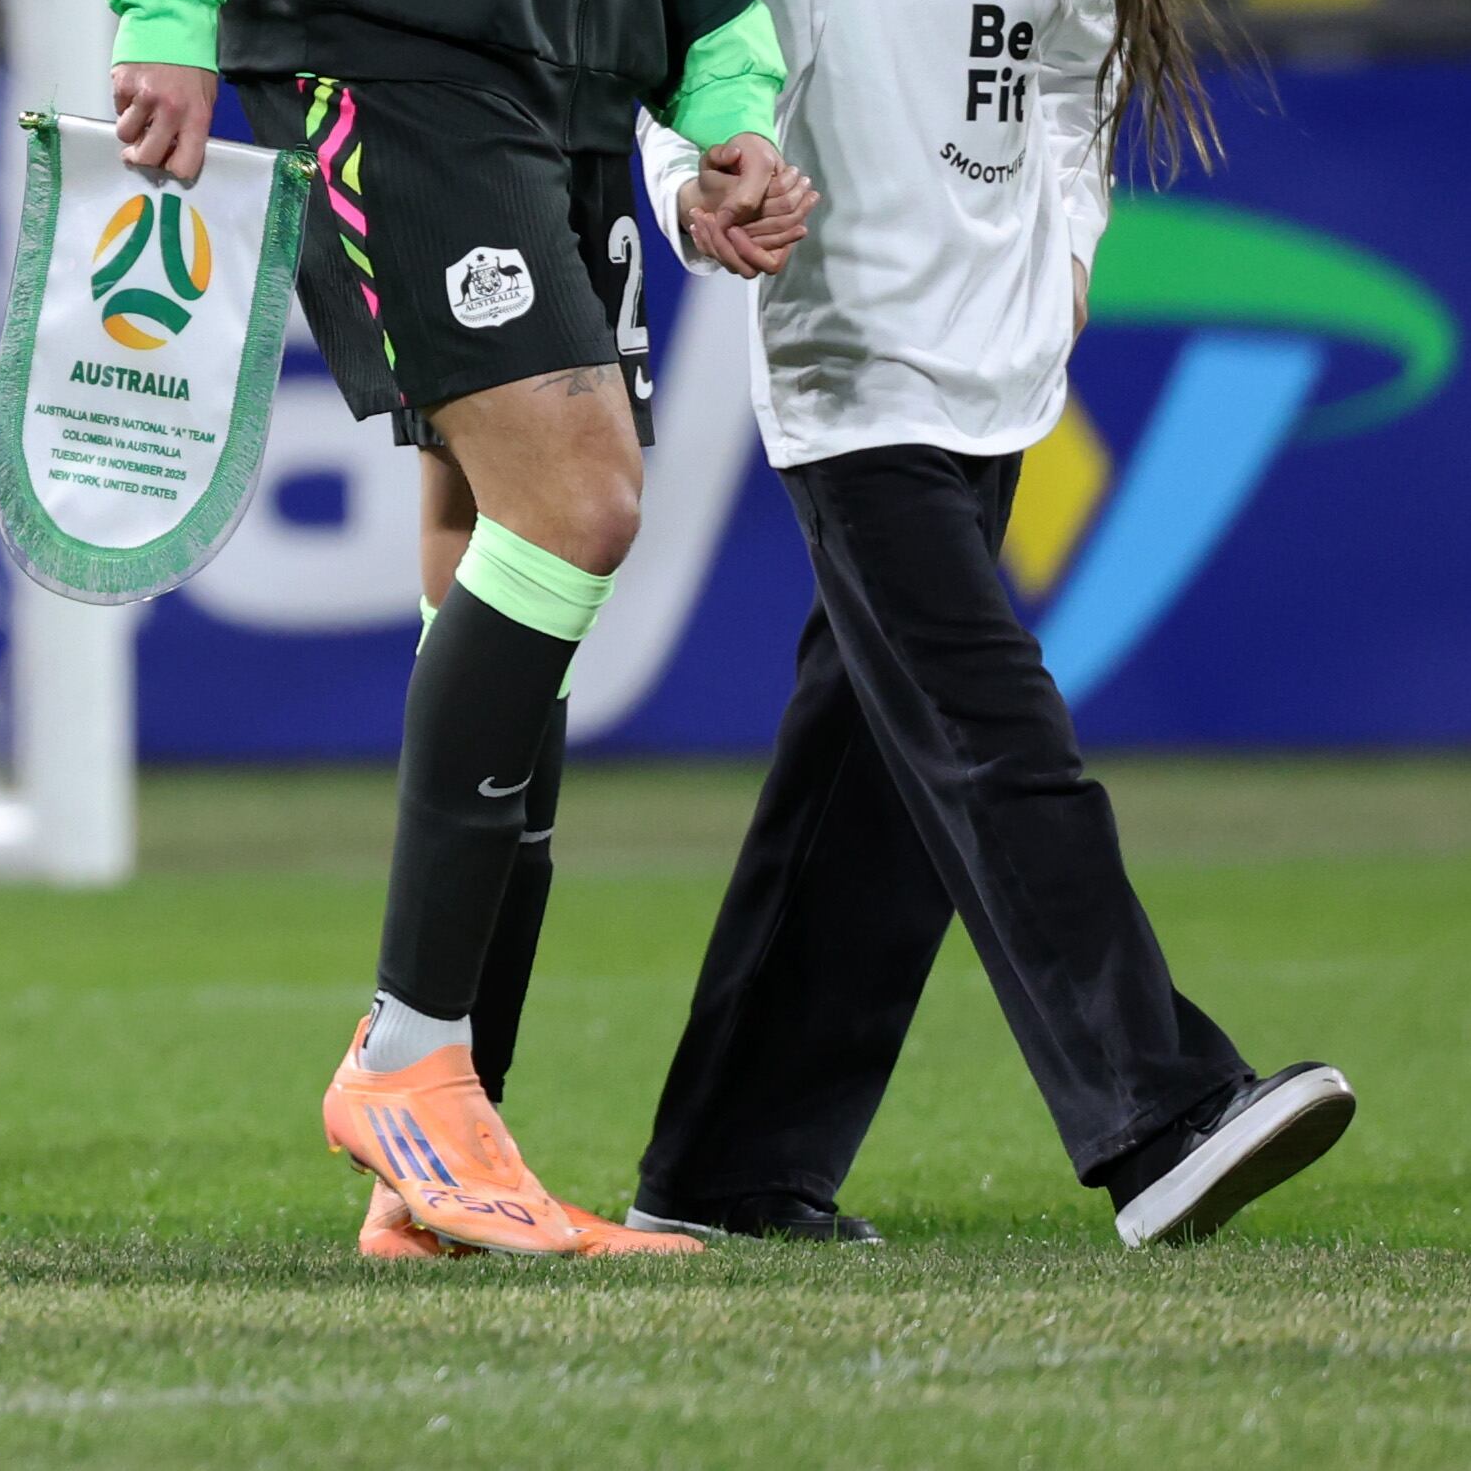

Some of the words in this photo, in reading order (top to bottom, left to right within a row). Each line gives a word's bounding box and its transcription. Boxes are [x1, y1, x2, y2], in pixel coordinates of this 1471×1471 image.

[969, 3, 1034, 61] Be
[966, 66, 1026, 122] Fit
[939, 142, 1026, 184] SMOOTHIE
[465, 291, 521, 313] AUSTRALIA
[69, 359, 191, 401] AUSTRALIA
[34, 404, 87, 421] AUSTRALIA
[89, 412, 120, 427] MEN'S
[122, 418, 168, 435] NATIONAL
[189, 429, 216, 443] TEAM
[62, 429, 112, 446] COLOMBIA
[126, 440, 181, 459] AUSTRALIA
[51, 448, 95, 463] TUESDAY
[97, 456, 107, 467] 18
[108, 458, 163, 477] NOVEMBER
[165, 468, 187, 480] 2025
[48, 469, 70, 480] NEW
[72, 472, 100, 488] YORK,
[103, 478, 139, 493] UNITED
[141, 483, 178, 500] STATES
